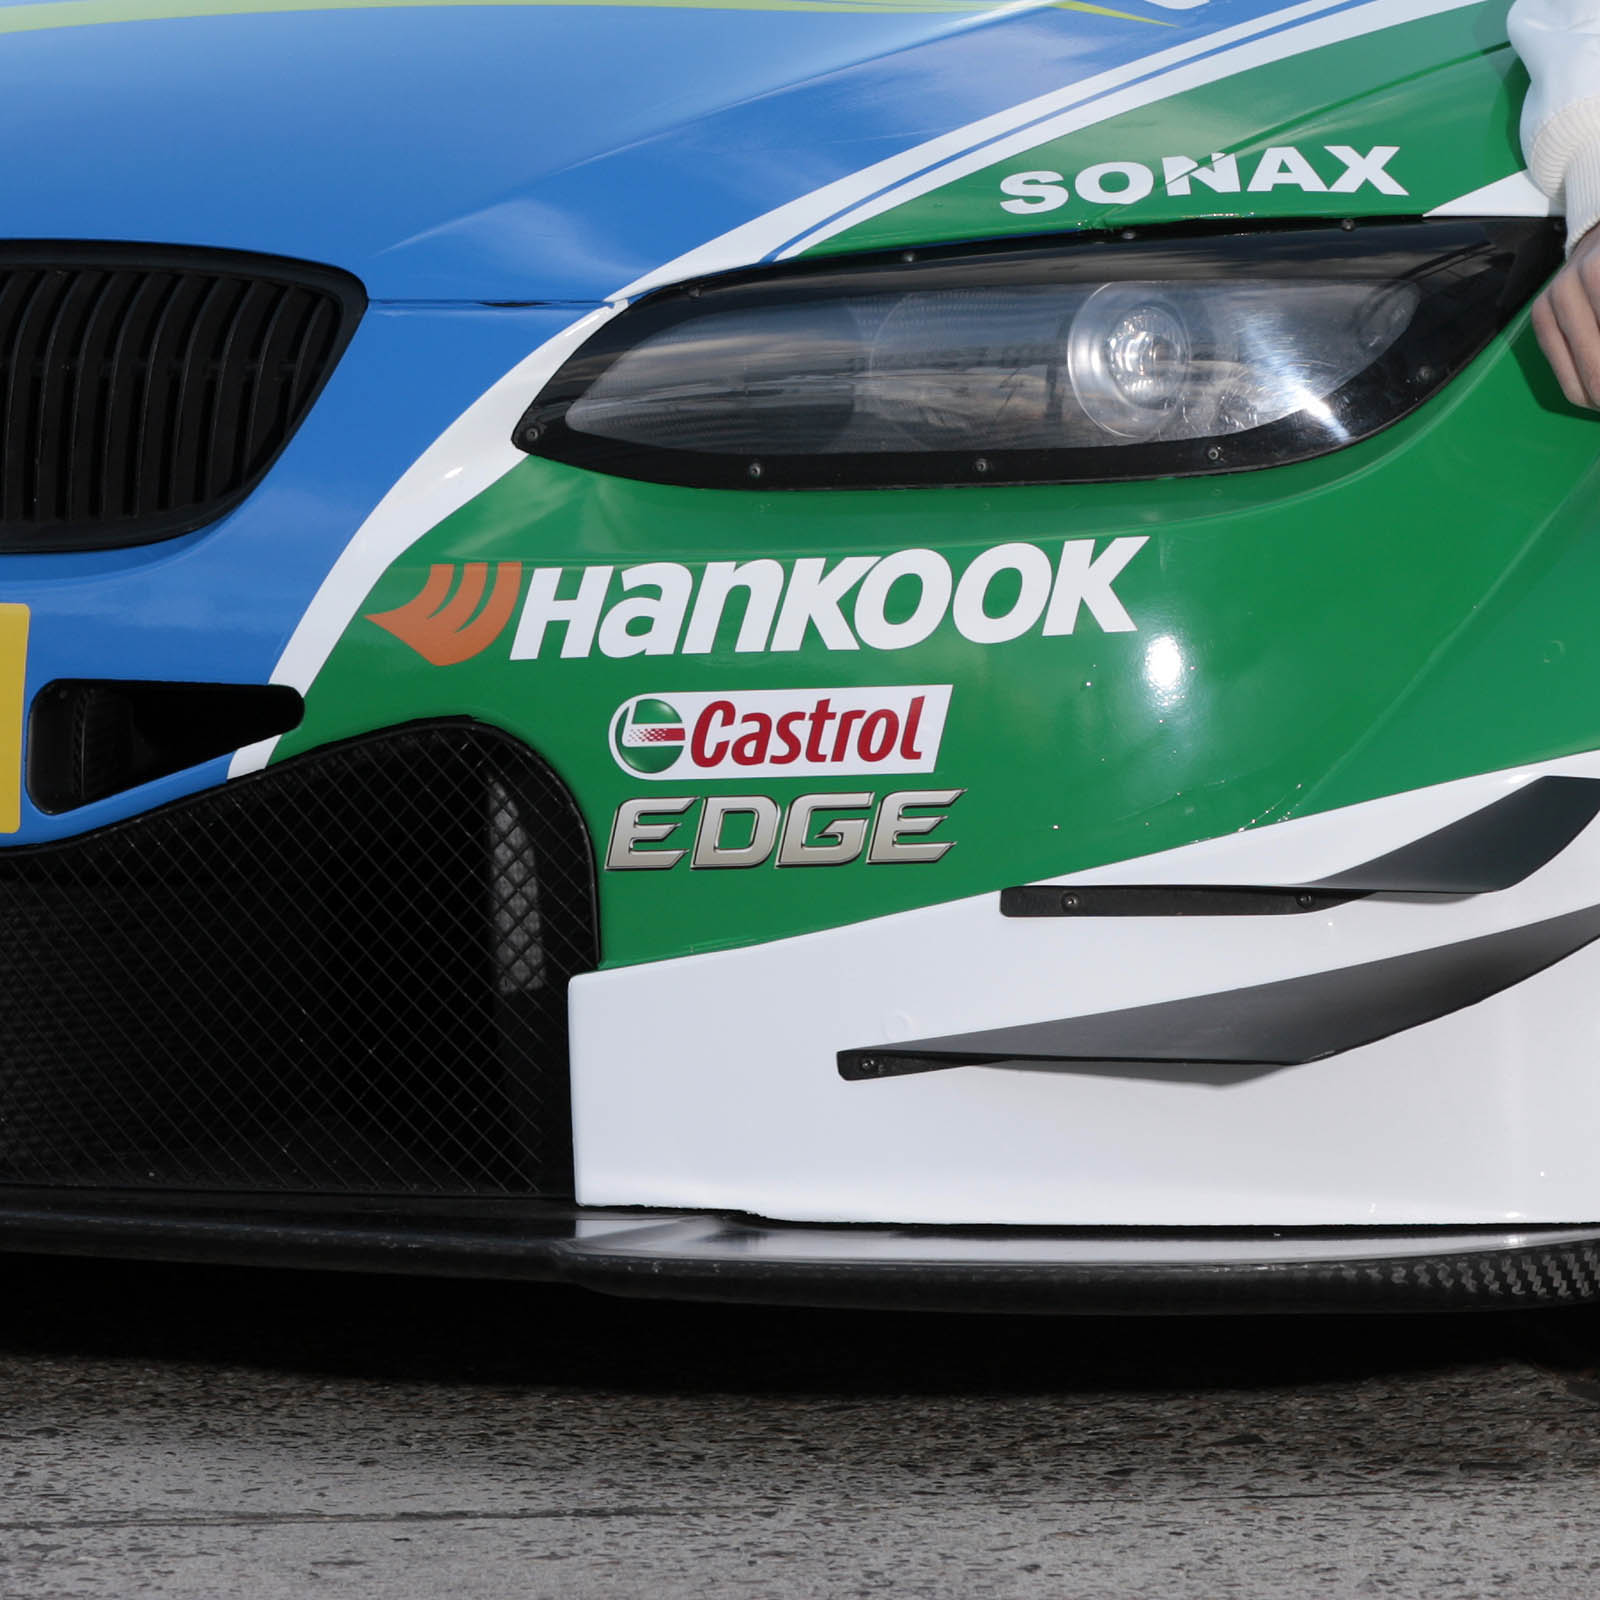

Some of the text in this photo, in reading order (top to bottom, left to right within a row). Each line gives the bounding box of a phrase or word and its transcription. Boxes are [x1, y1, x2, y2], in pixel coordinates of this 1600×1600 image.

[999, 144, 1409, 215] SONAX
[689, 696, 926, 770] Castrol
[604, 788, 968, 871] EDGE
